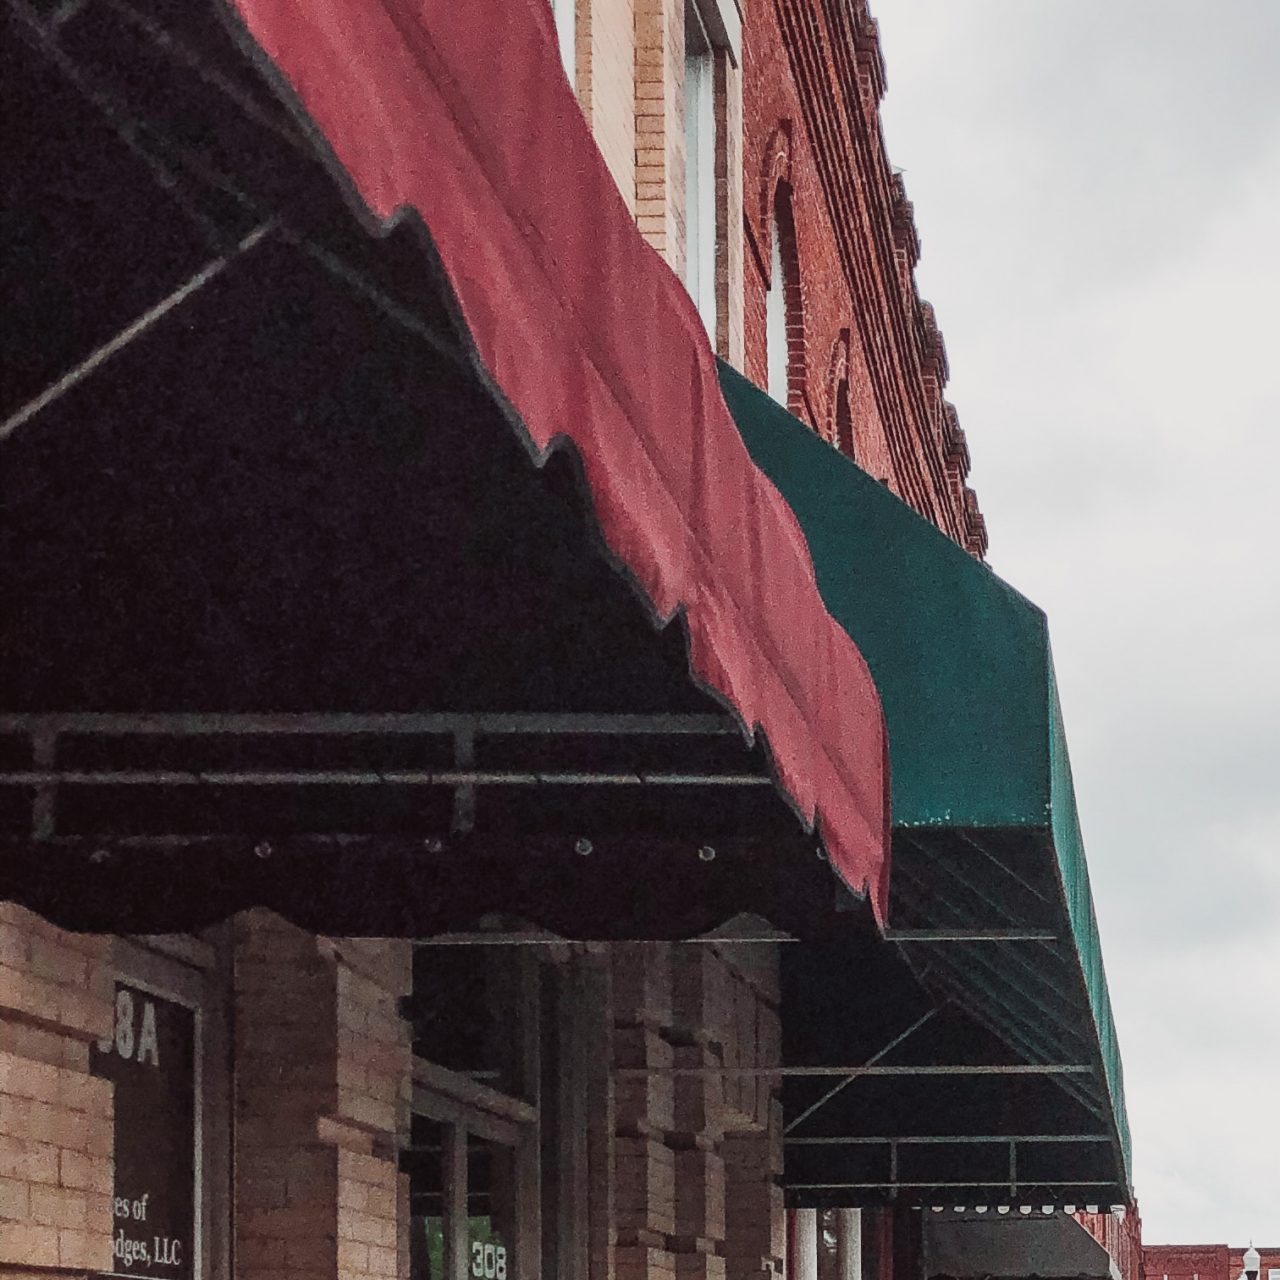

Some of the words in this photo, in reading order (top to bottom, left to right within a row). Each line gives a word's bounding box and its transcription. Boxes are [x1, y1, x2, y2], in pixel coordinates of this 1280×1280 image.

[97, 990, 159, 1066] 8A
[132, 1193, 149, 1221] of
[113, 1229, 151, 1268] dges,
[154, 1236, 180, 1266] LLC
[472, 1241, 507, 1280] 308
